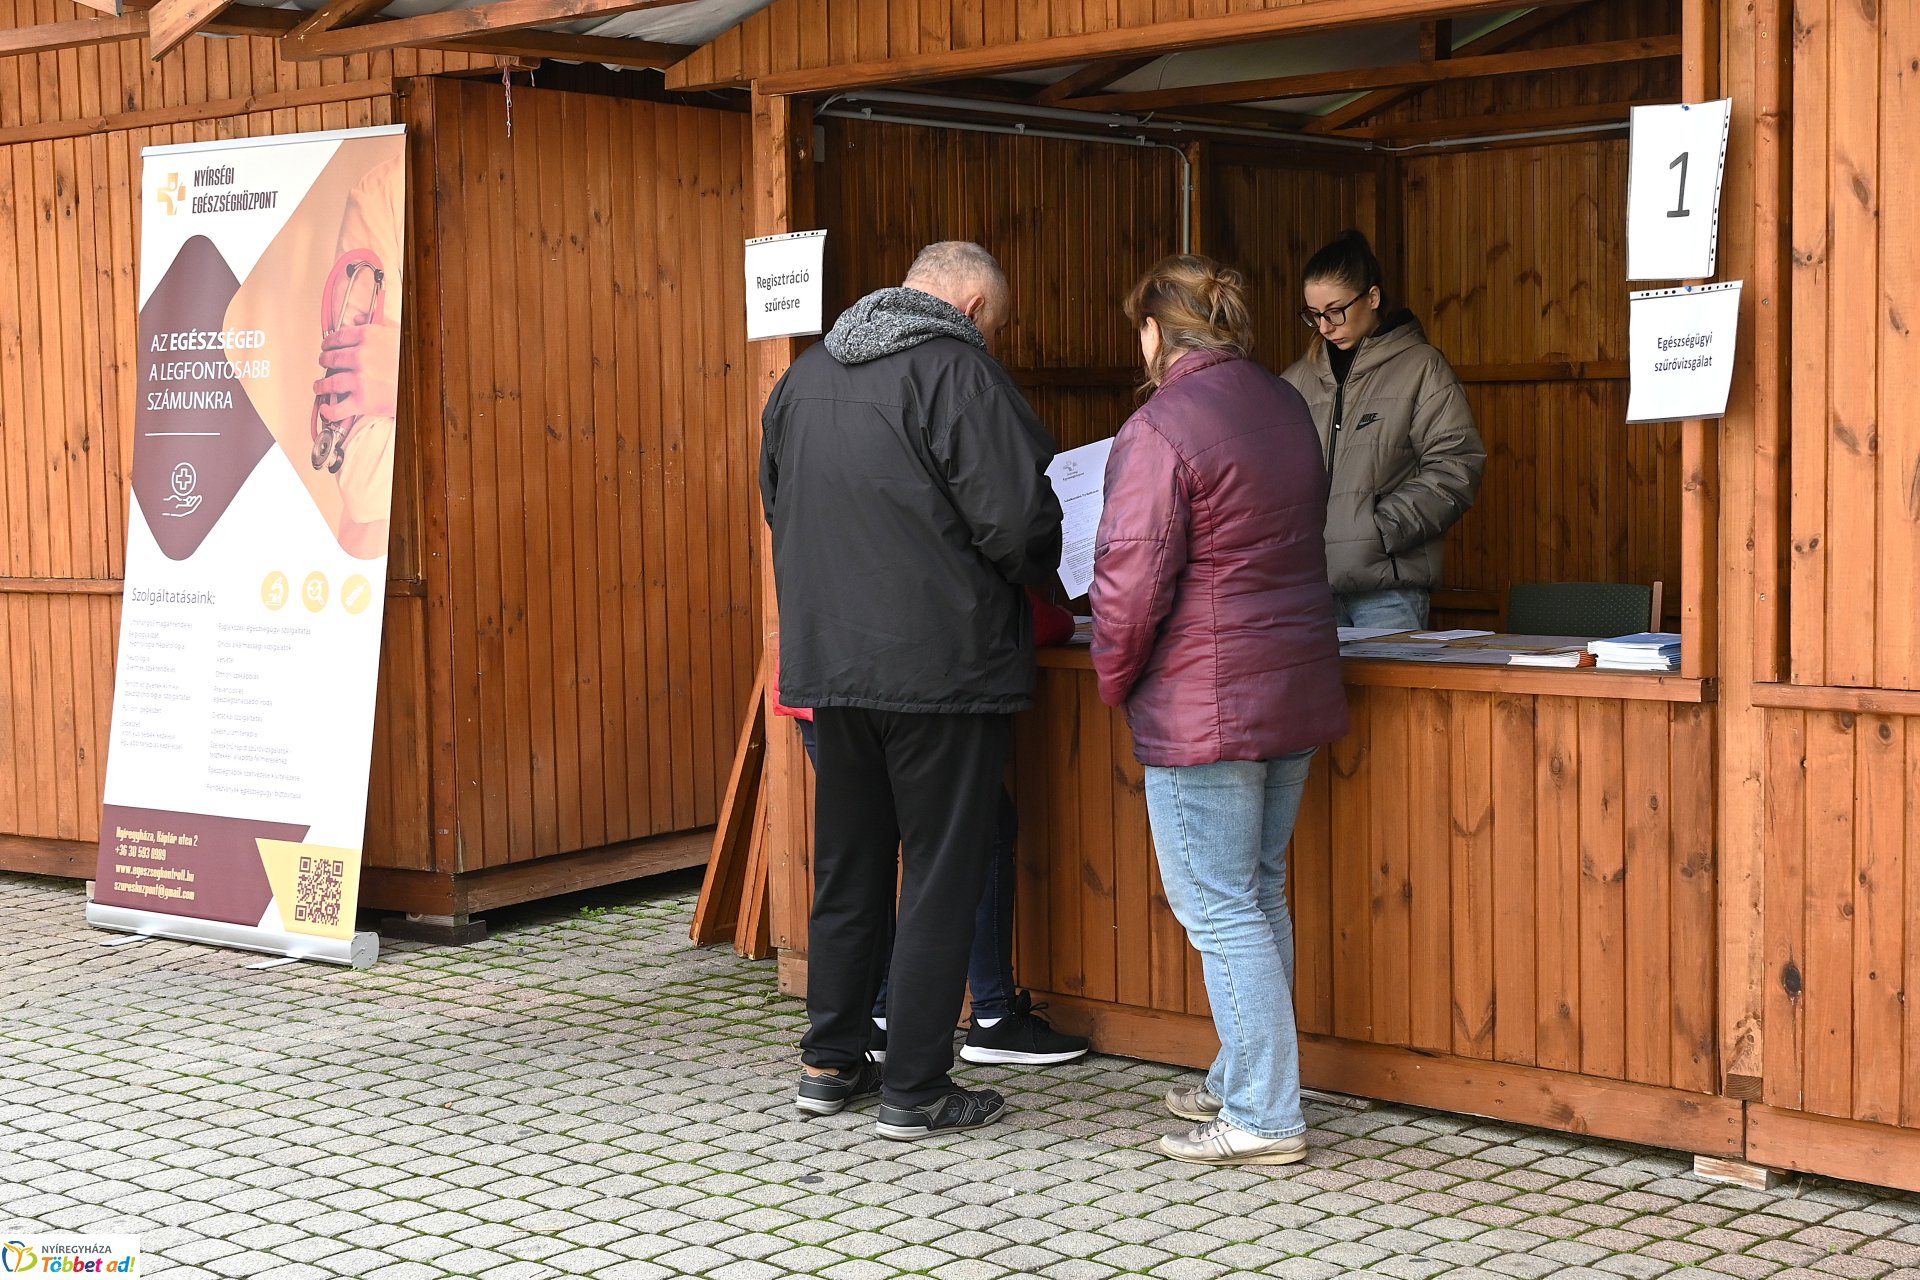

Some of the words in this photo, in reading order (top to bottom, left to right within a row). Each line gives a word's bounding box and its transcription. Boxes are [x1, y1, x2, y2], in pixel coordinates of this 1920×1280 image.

[194, 165, 235, 187] NYÍRSÉGI
[1666, 151, 1690, 218] 1
[192, 190, 278, 214] EGÉSZSÉGKÖZPONT
[756, 268, 810, 290] Regisztráció
[764, 296, 801, 312] szűrésre
[151, 333, 168, 352] AZ
[170, 327, 266, 351] EGÉSZSÉGED
[1657, 331, 1713, 351] Egészségügyi
[149, 363, 158, 381] A
[160, 359, 271, 381] LEGFONTOSABB
[1654, 355, 1713, 372] szűrővizsgálat
[147, 388, 233, 411] SZÁMUNKRA
[132, 587, 216, 606] Szolgáltatásaink:
[115, 844, 127, 856] +36
[128, 845, 137, 858] 30
[138, 846, 150, 858] 593
[178, 834, 193, 846] utca
[193, 835, 199, 847] 2
